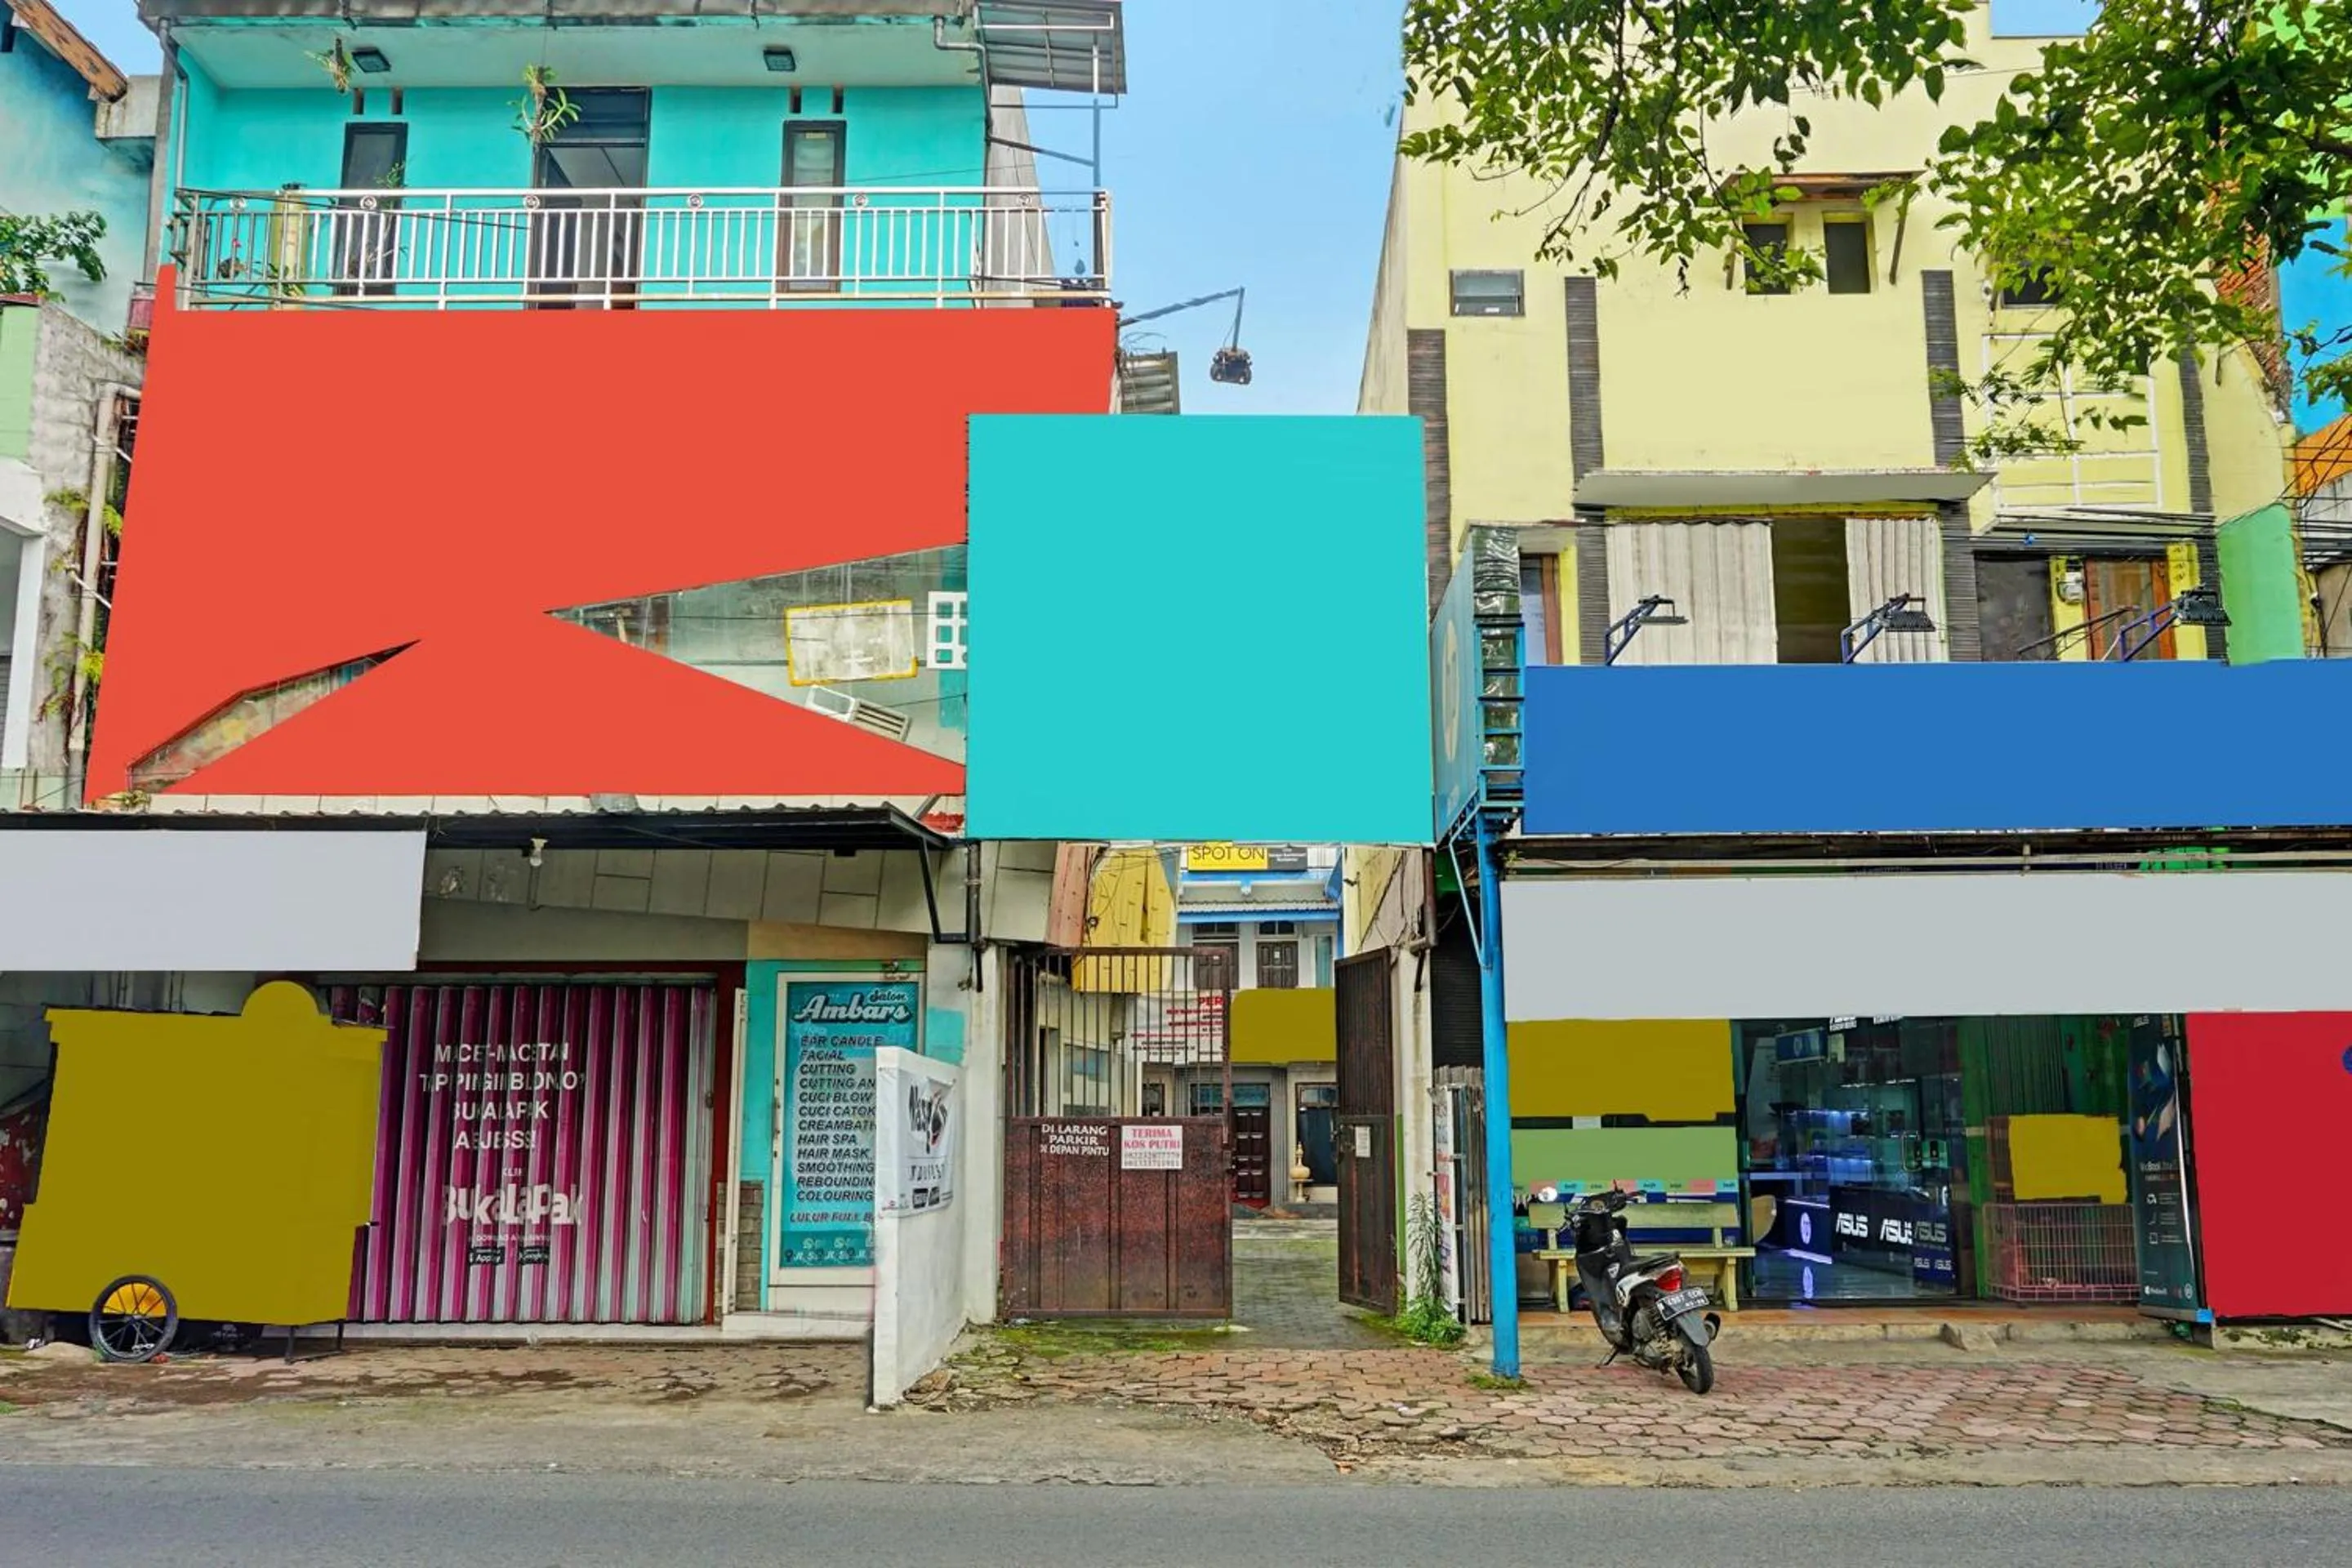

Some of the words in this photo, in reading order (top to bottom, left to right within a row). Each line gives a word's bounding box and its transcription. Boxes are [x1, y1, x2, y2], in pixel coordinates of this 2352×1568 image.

[1192, 844, 1232, 860] SPOT
[1238, 846, 1264, 860] ON
[794, 993, 911, 1021] Ambars
[831, 1036, 884, 1046] CANDLE
[801, 1050, 845, 1061] FACIAL
[800, 1064, 856, 1075] CUTTING
[800, 1078, 855, 1089] CUTTING
[800, 1092, 831, 1102] CUCI
[833, 1092, 872, 1102] BLOW
[800, 1106, 831, 1116] CUCI
[833, 1106, 875, 1116] CATOK
[1041, 1124, 1054, 1134] DI
[1058, 1125, 1107, 1136] LARANG
[1131, 1129, 1173, 1138] TERIMA
[798, 1134, 829, 1144] HAIR
[832, 1134, 858, 1144] SPA
[1049, 1134, 1098, 1146] PARKIR
[1124, 1139, 1144, 1149] KOS
[798, 1147, 829, 1159] HAIR
[832, 1147, 871, 1159] MASK
[1049, 1144, 1080, 1155] DEPAN
[1081, 1146, 1110, 1156] PINTU
[797, 1162, 875, 1173] SMOOTHING
[796, 1190, 874, 1201] COLOURING
[1836, 1212, 1869, 1238] ASUS
[1914, 1221, 1947, 1243] ASUS
